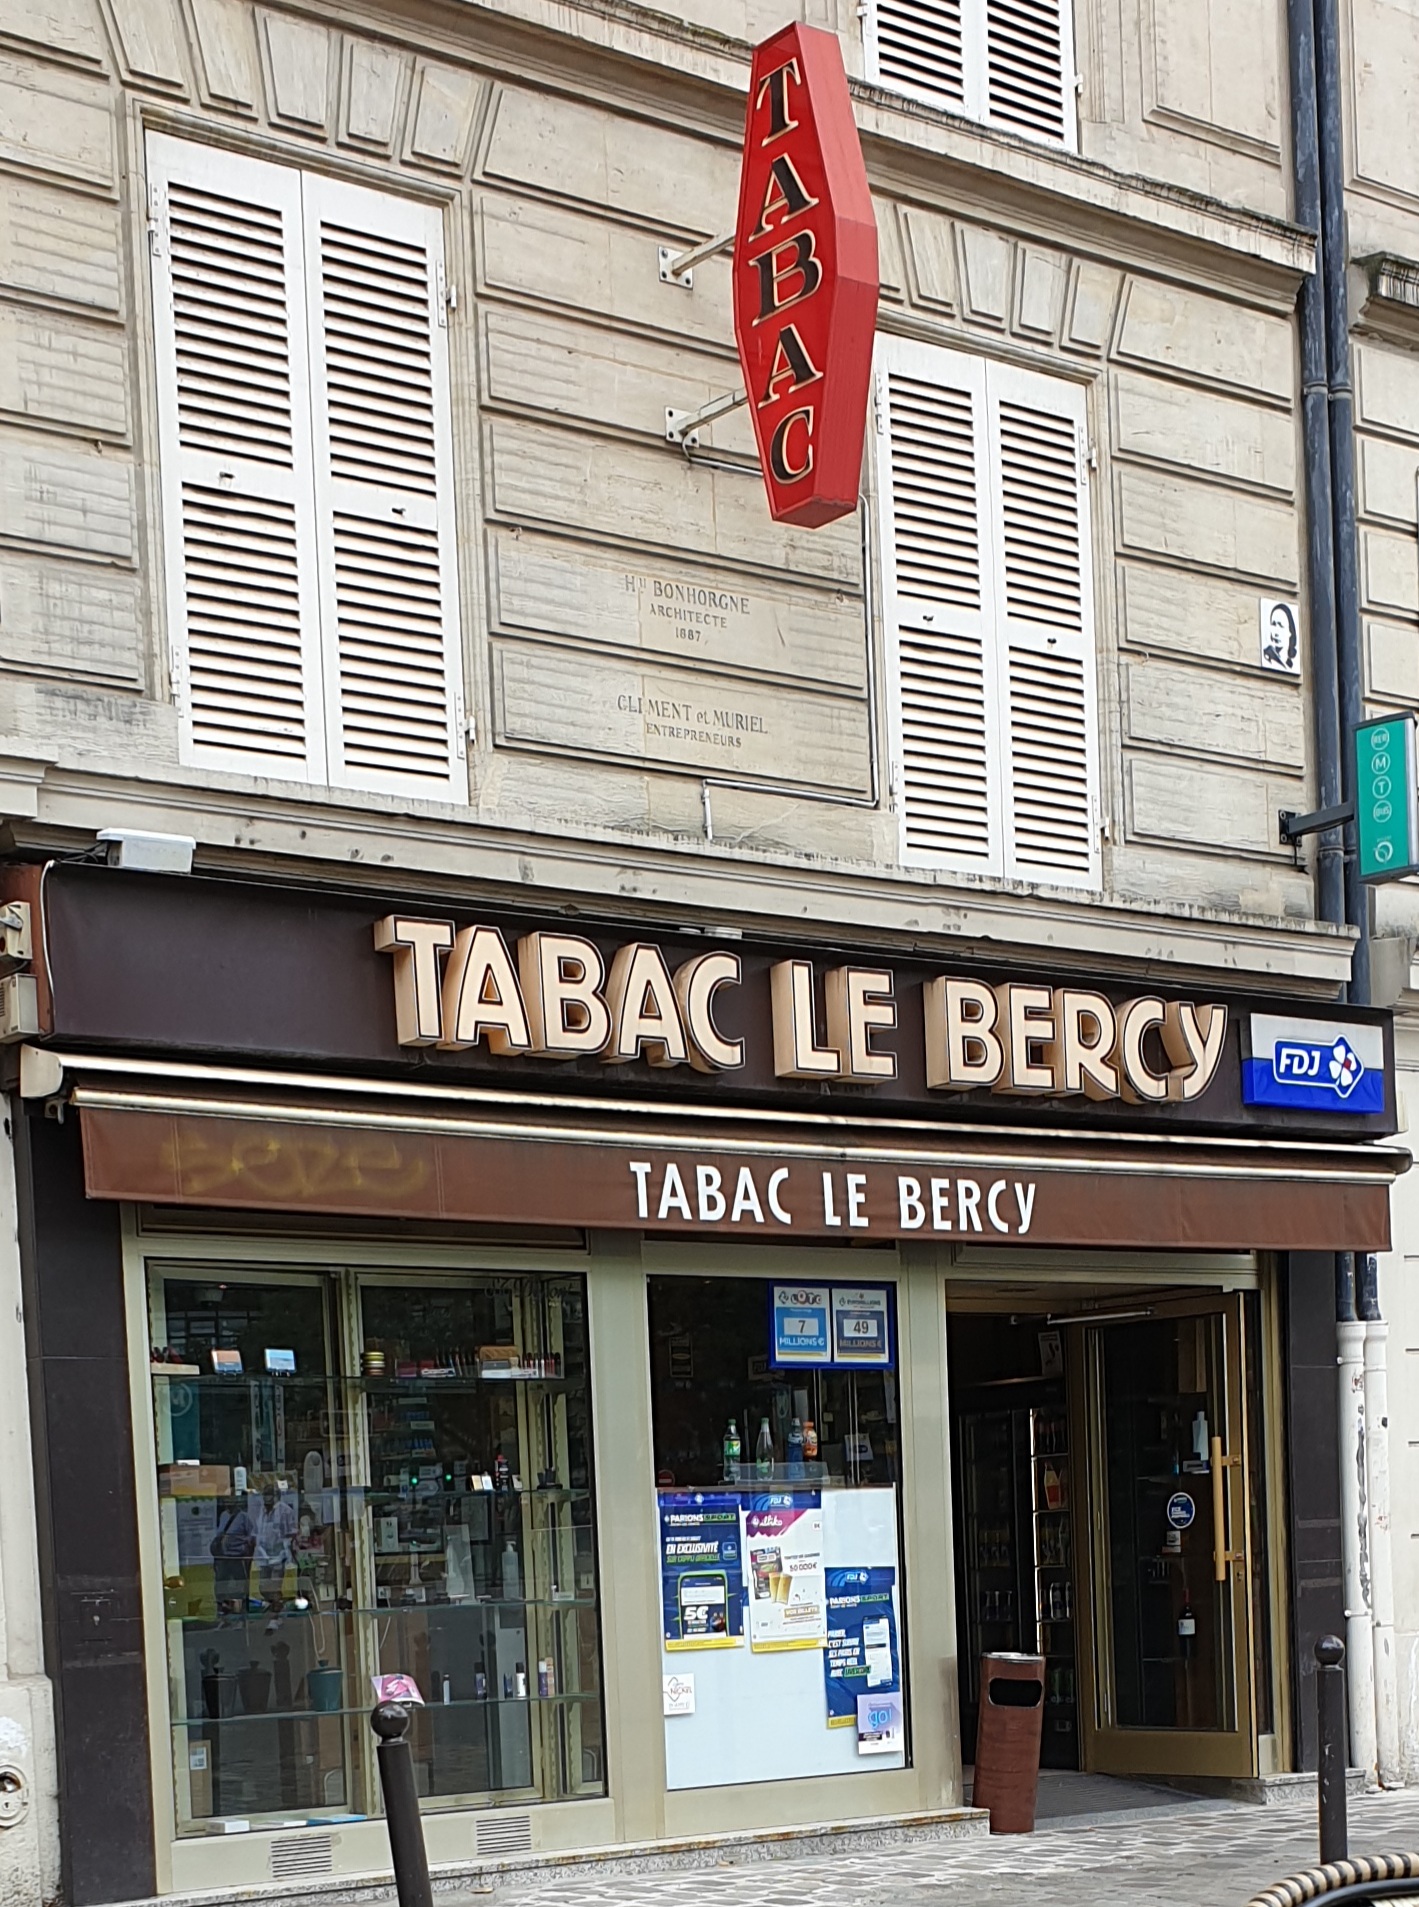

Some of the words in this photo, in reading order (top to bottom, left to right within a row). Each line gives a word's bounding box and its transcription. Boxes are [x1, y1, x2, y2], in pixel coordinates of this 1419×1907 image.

[748, 57, 825, 486] TABAC
[653, 580, 751, 615] BONHORGNE
[649, 603, 728, 629] ARCHITECTE
[675, 627, 701, 642] 1887
[696, 711, 710, 724] et
[713, 709, 769, 734] MURIEL
[646, 722, 742, 748] ENTREPRENEURS
[1375, 756, 1386, 771] M
[1377, 781, 1386, 794] T
[374, 914, 746, 1074] TABAC
[770, 959, 898, 1084] LE
[923, 975, 1228, 1104] BERCY
[1279, 1047, 1321, 1077] FDJ
[629, 1161, 792, 1225] TABAC
[822, 1172, 869, 1228] LE
[897, 1176, 1036, 1235] BERCY
[798, 1320, 806, 1334] 7
[853, 1320, 869, 1334] 49
